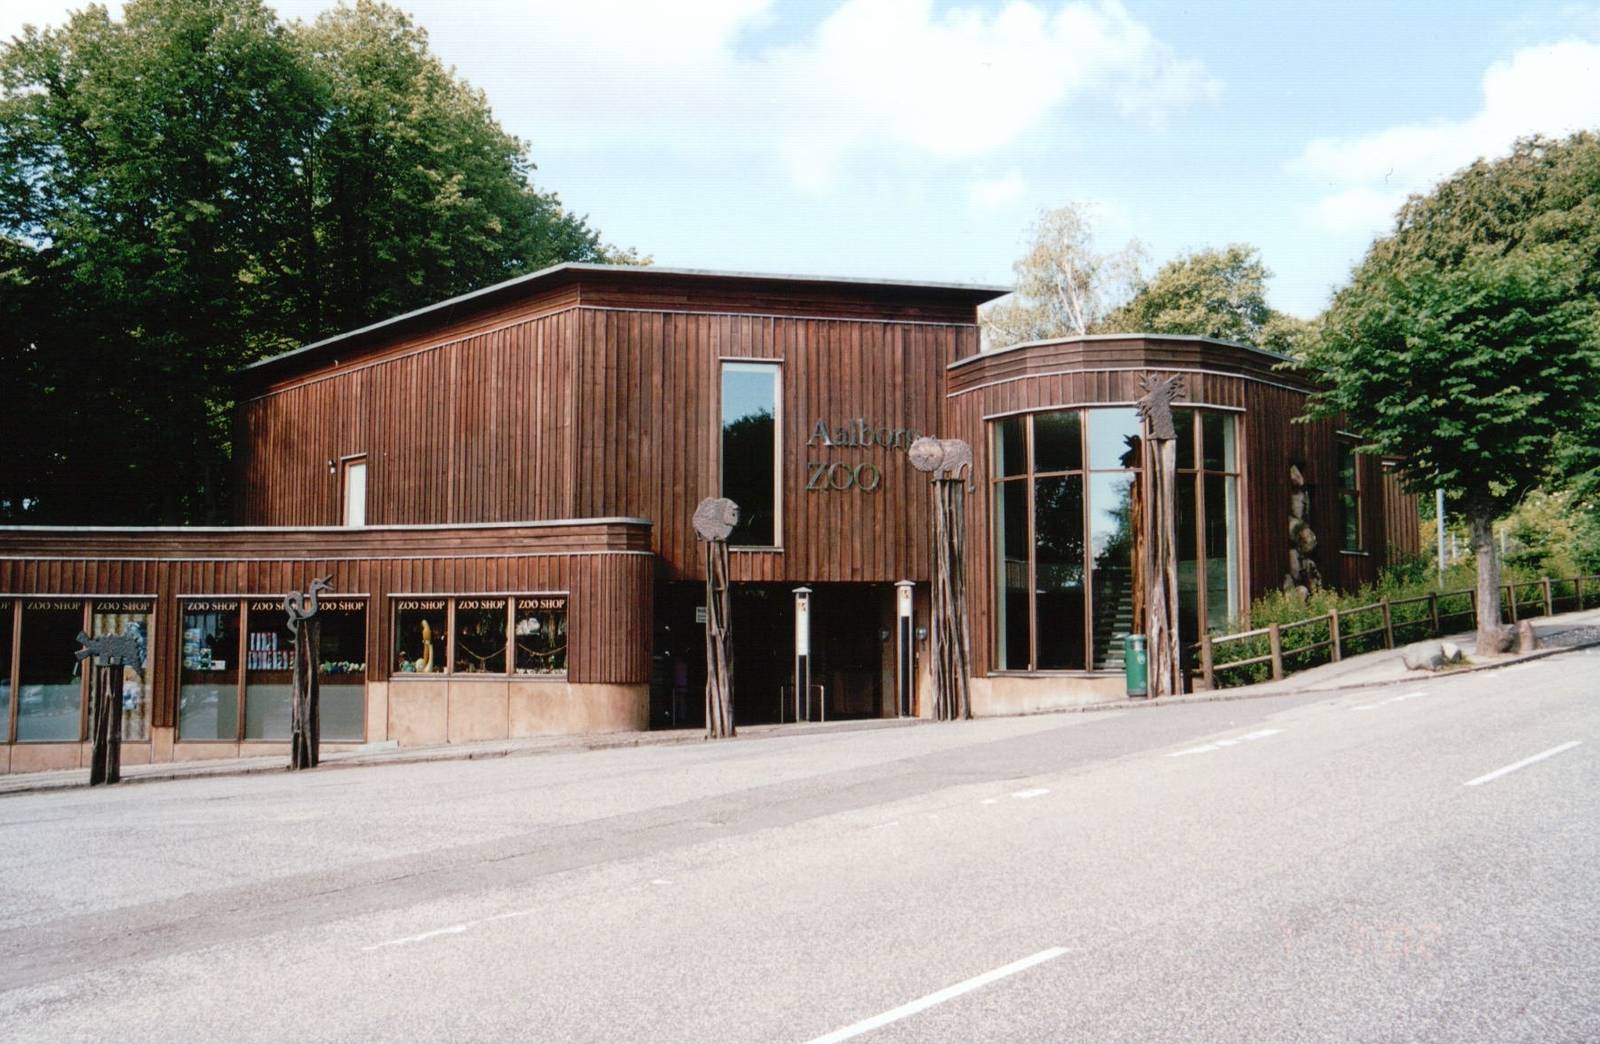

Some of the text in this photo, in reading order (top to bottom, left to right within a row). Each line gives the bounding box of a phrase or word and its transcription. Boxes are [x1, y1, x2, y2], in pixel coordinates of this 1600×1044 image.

[806, 461, 880, 490] ZOO
[27, 601, 80, 610] ZOO SHOP
[97, 601, 150, 610] ZOO SHOP
[187, 602, 238, 611] ZOO SHOP
[252, 602, 274, 611] ZOO
[319, 601, 364, 611] OO SHOP
[398, 601, 445, 610] ZOO SHOP
[458, 601, 505, 609] ZOO SHOP
[519, 600, 565, 609] ZOO SHOP
